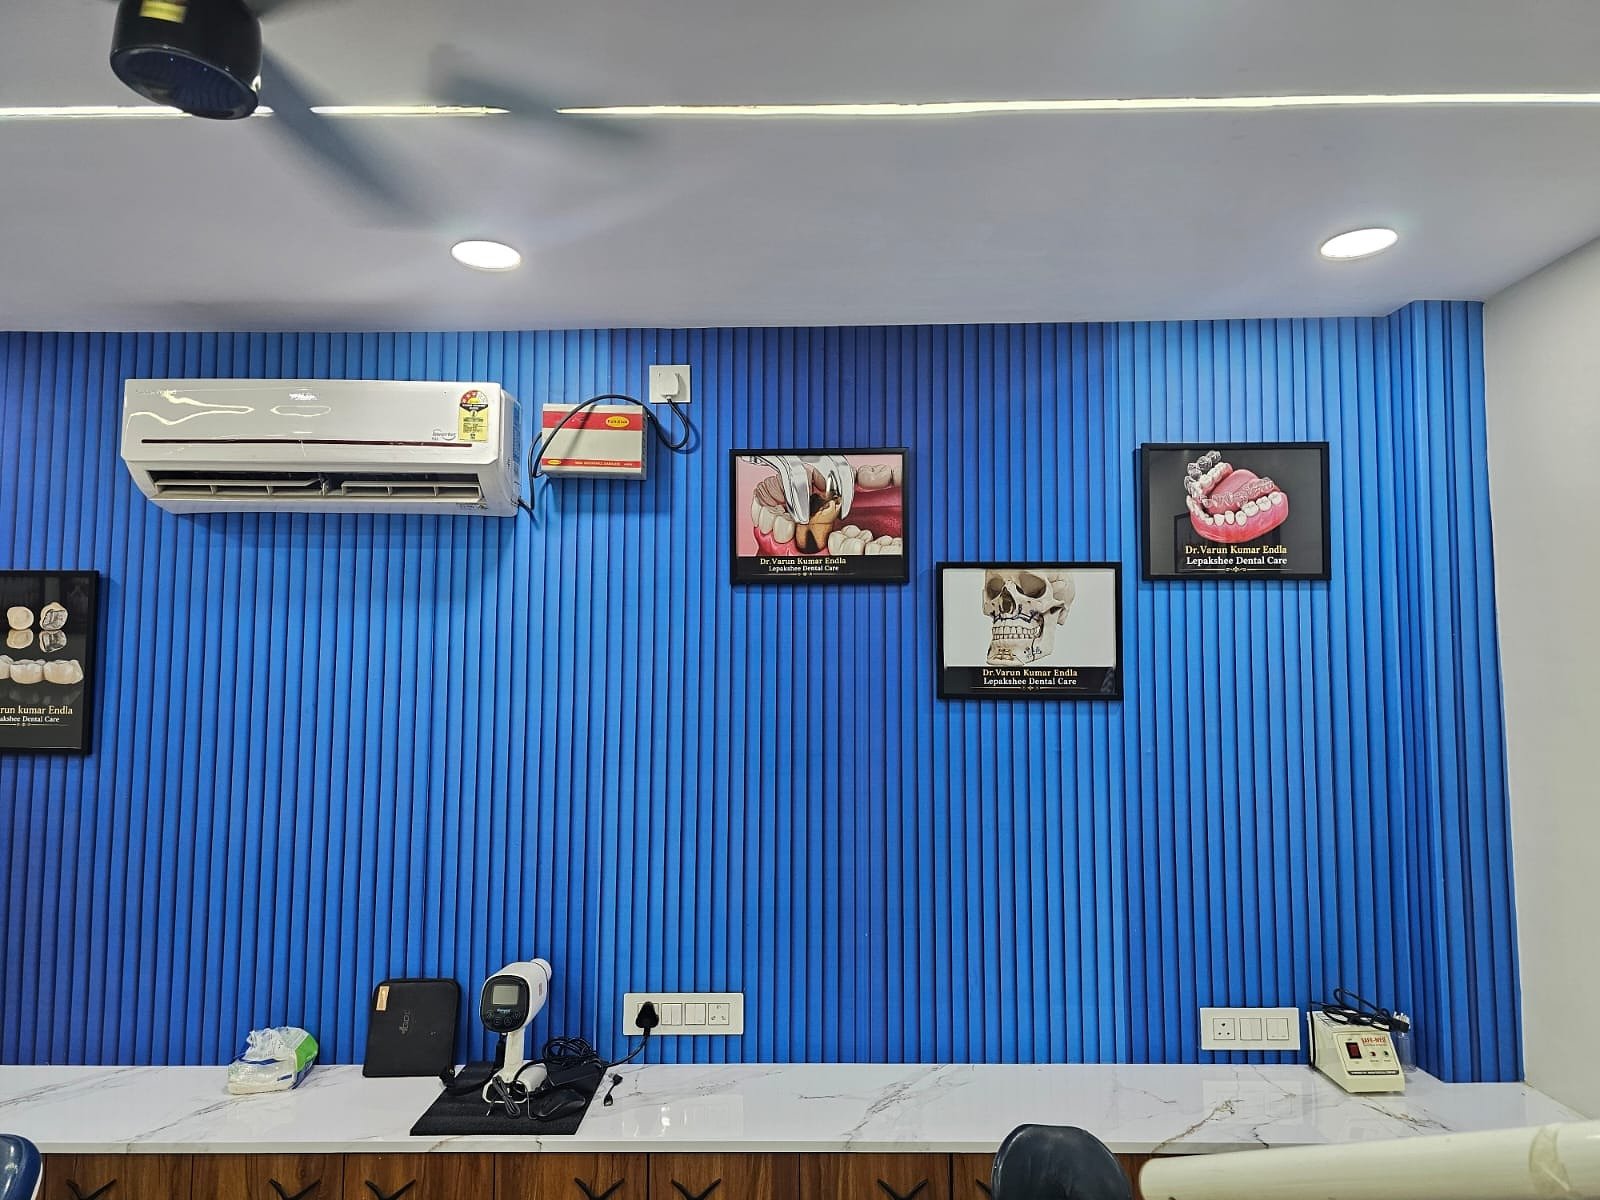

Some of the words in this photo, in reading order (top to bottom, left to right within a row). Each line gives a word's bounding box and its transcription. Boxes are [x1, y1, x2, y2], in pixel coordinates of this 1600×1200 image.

[1230, 545, 1260, 554] Kumar
[1262, 545, 1287, 554] Endla
[797, 557, 822, 565] Kumar
[1186, 556, 1233, 566] Lepakshee
[1236, 556, 1265, 565] Dental
[1267, 556, 1288, 565] Care
[768, 565, 801, 573] Lepakshee
[1023, 668, 1052, 677] Kumar
[1054, 668, 1078, 677] Endla
[983, 677, 1027, 686] Lepakshee
[1029, 677, 1056, 685] Dental
[1057, 677, 1077, 685] Care
[18, 705, 47, 715] kumar
[48, 705, 73, 715] Endla
[22, 715, 43, 723] Dental
[44, 715, 60, 723] Care
